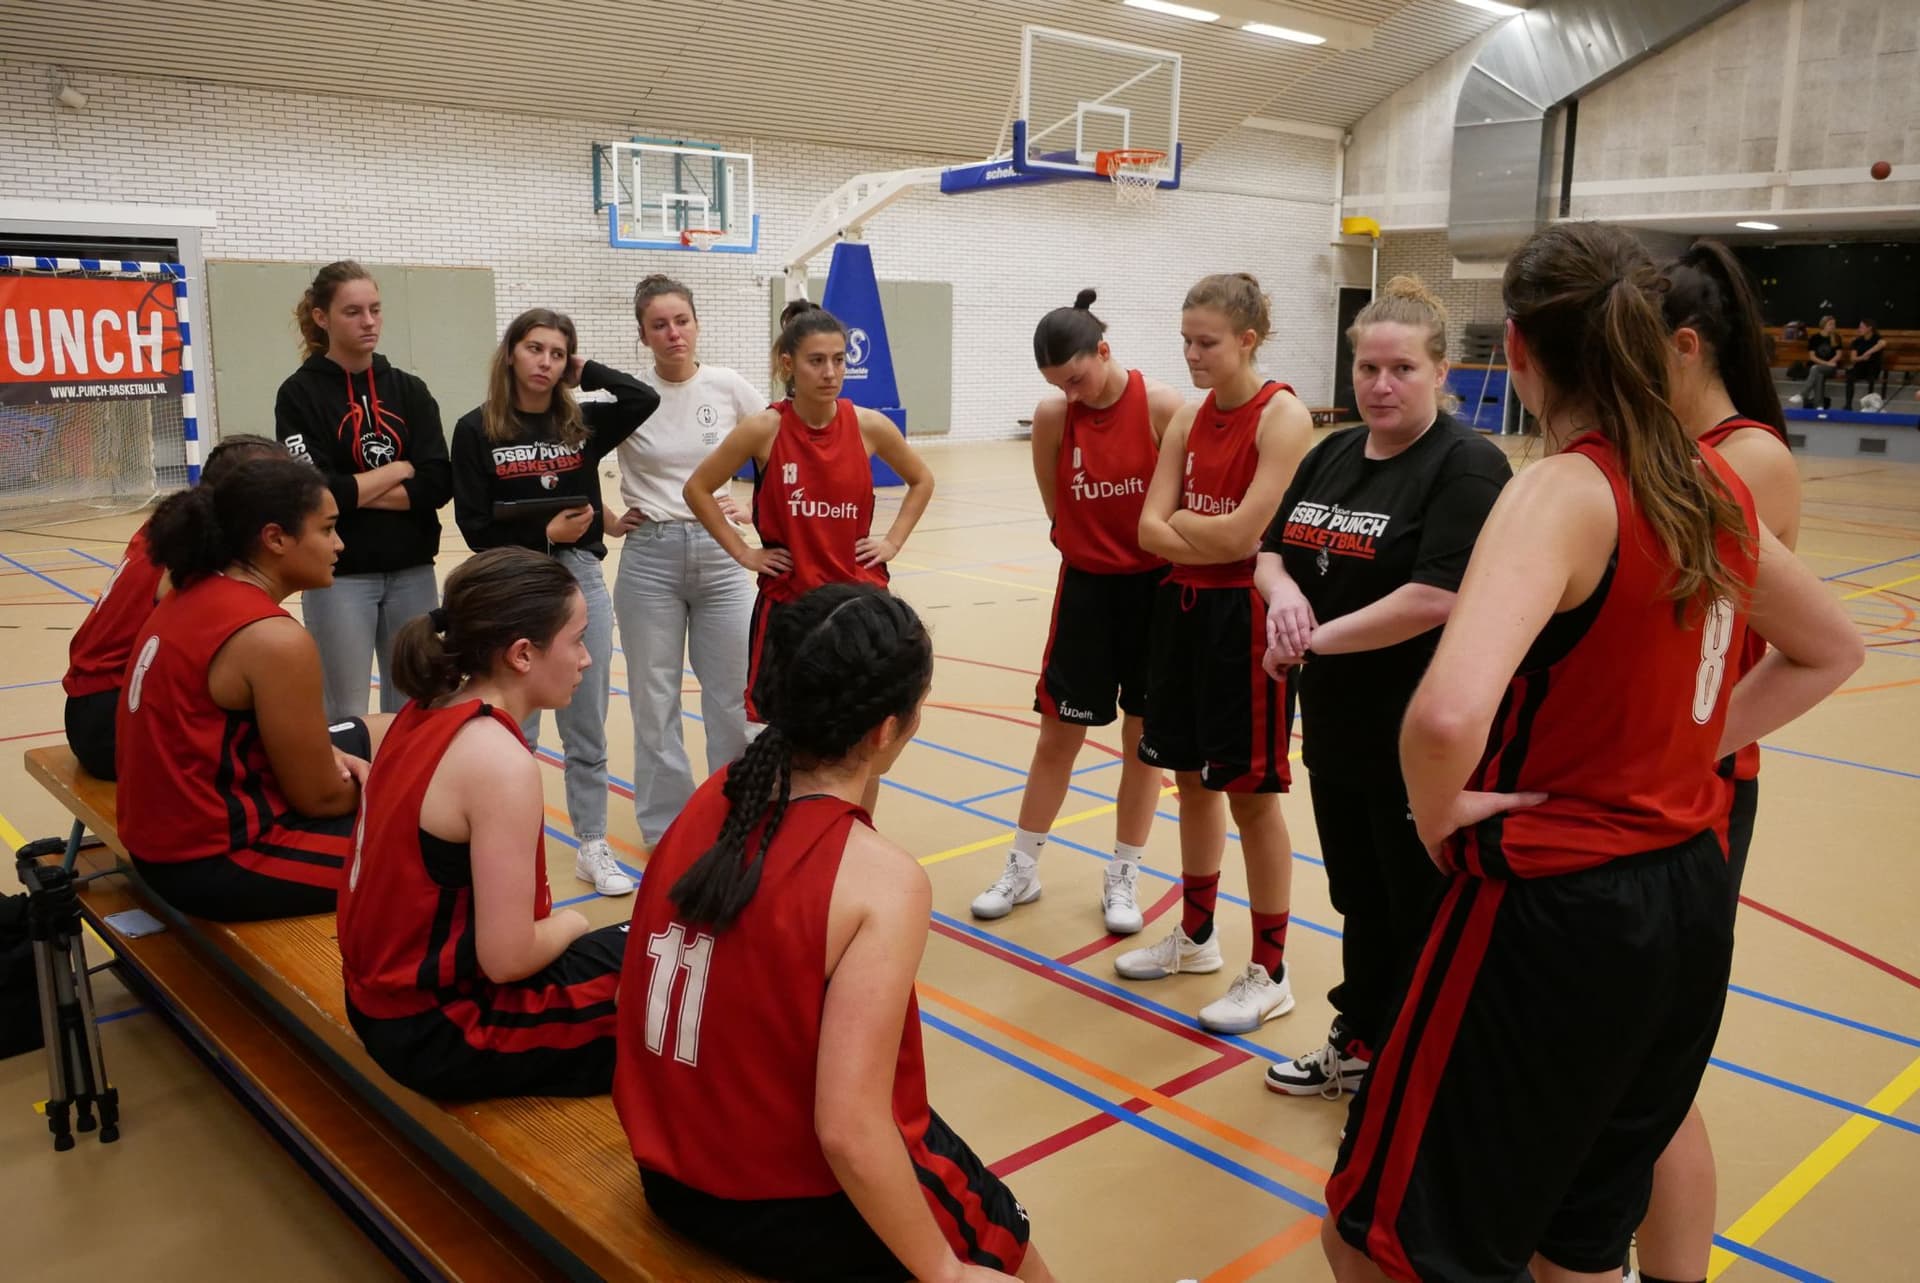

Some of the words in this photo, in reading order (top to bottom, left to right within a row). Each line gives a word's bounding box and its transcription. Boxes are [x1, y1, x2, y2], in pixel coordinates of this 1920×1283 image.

[5, 309, 163, 376] UNCH
[50, 382, 167, 398] WWW.PUNCH-BASKETBALL.NL
[492, 446, 538, 466] DSBV
[1327, 514, 1389, 538] PUNCH
[1692, 596, 1735, 725] 8
[645, 921, 715, 1068] 11
